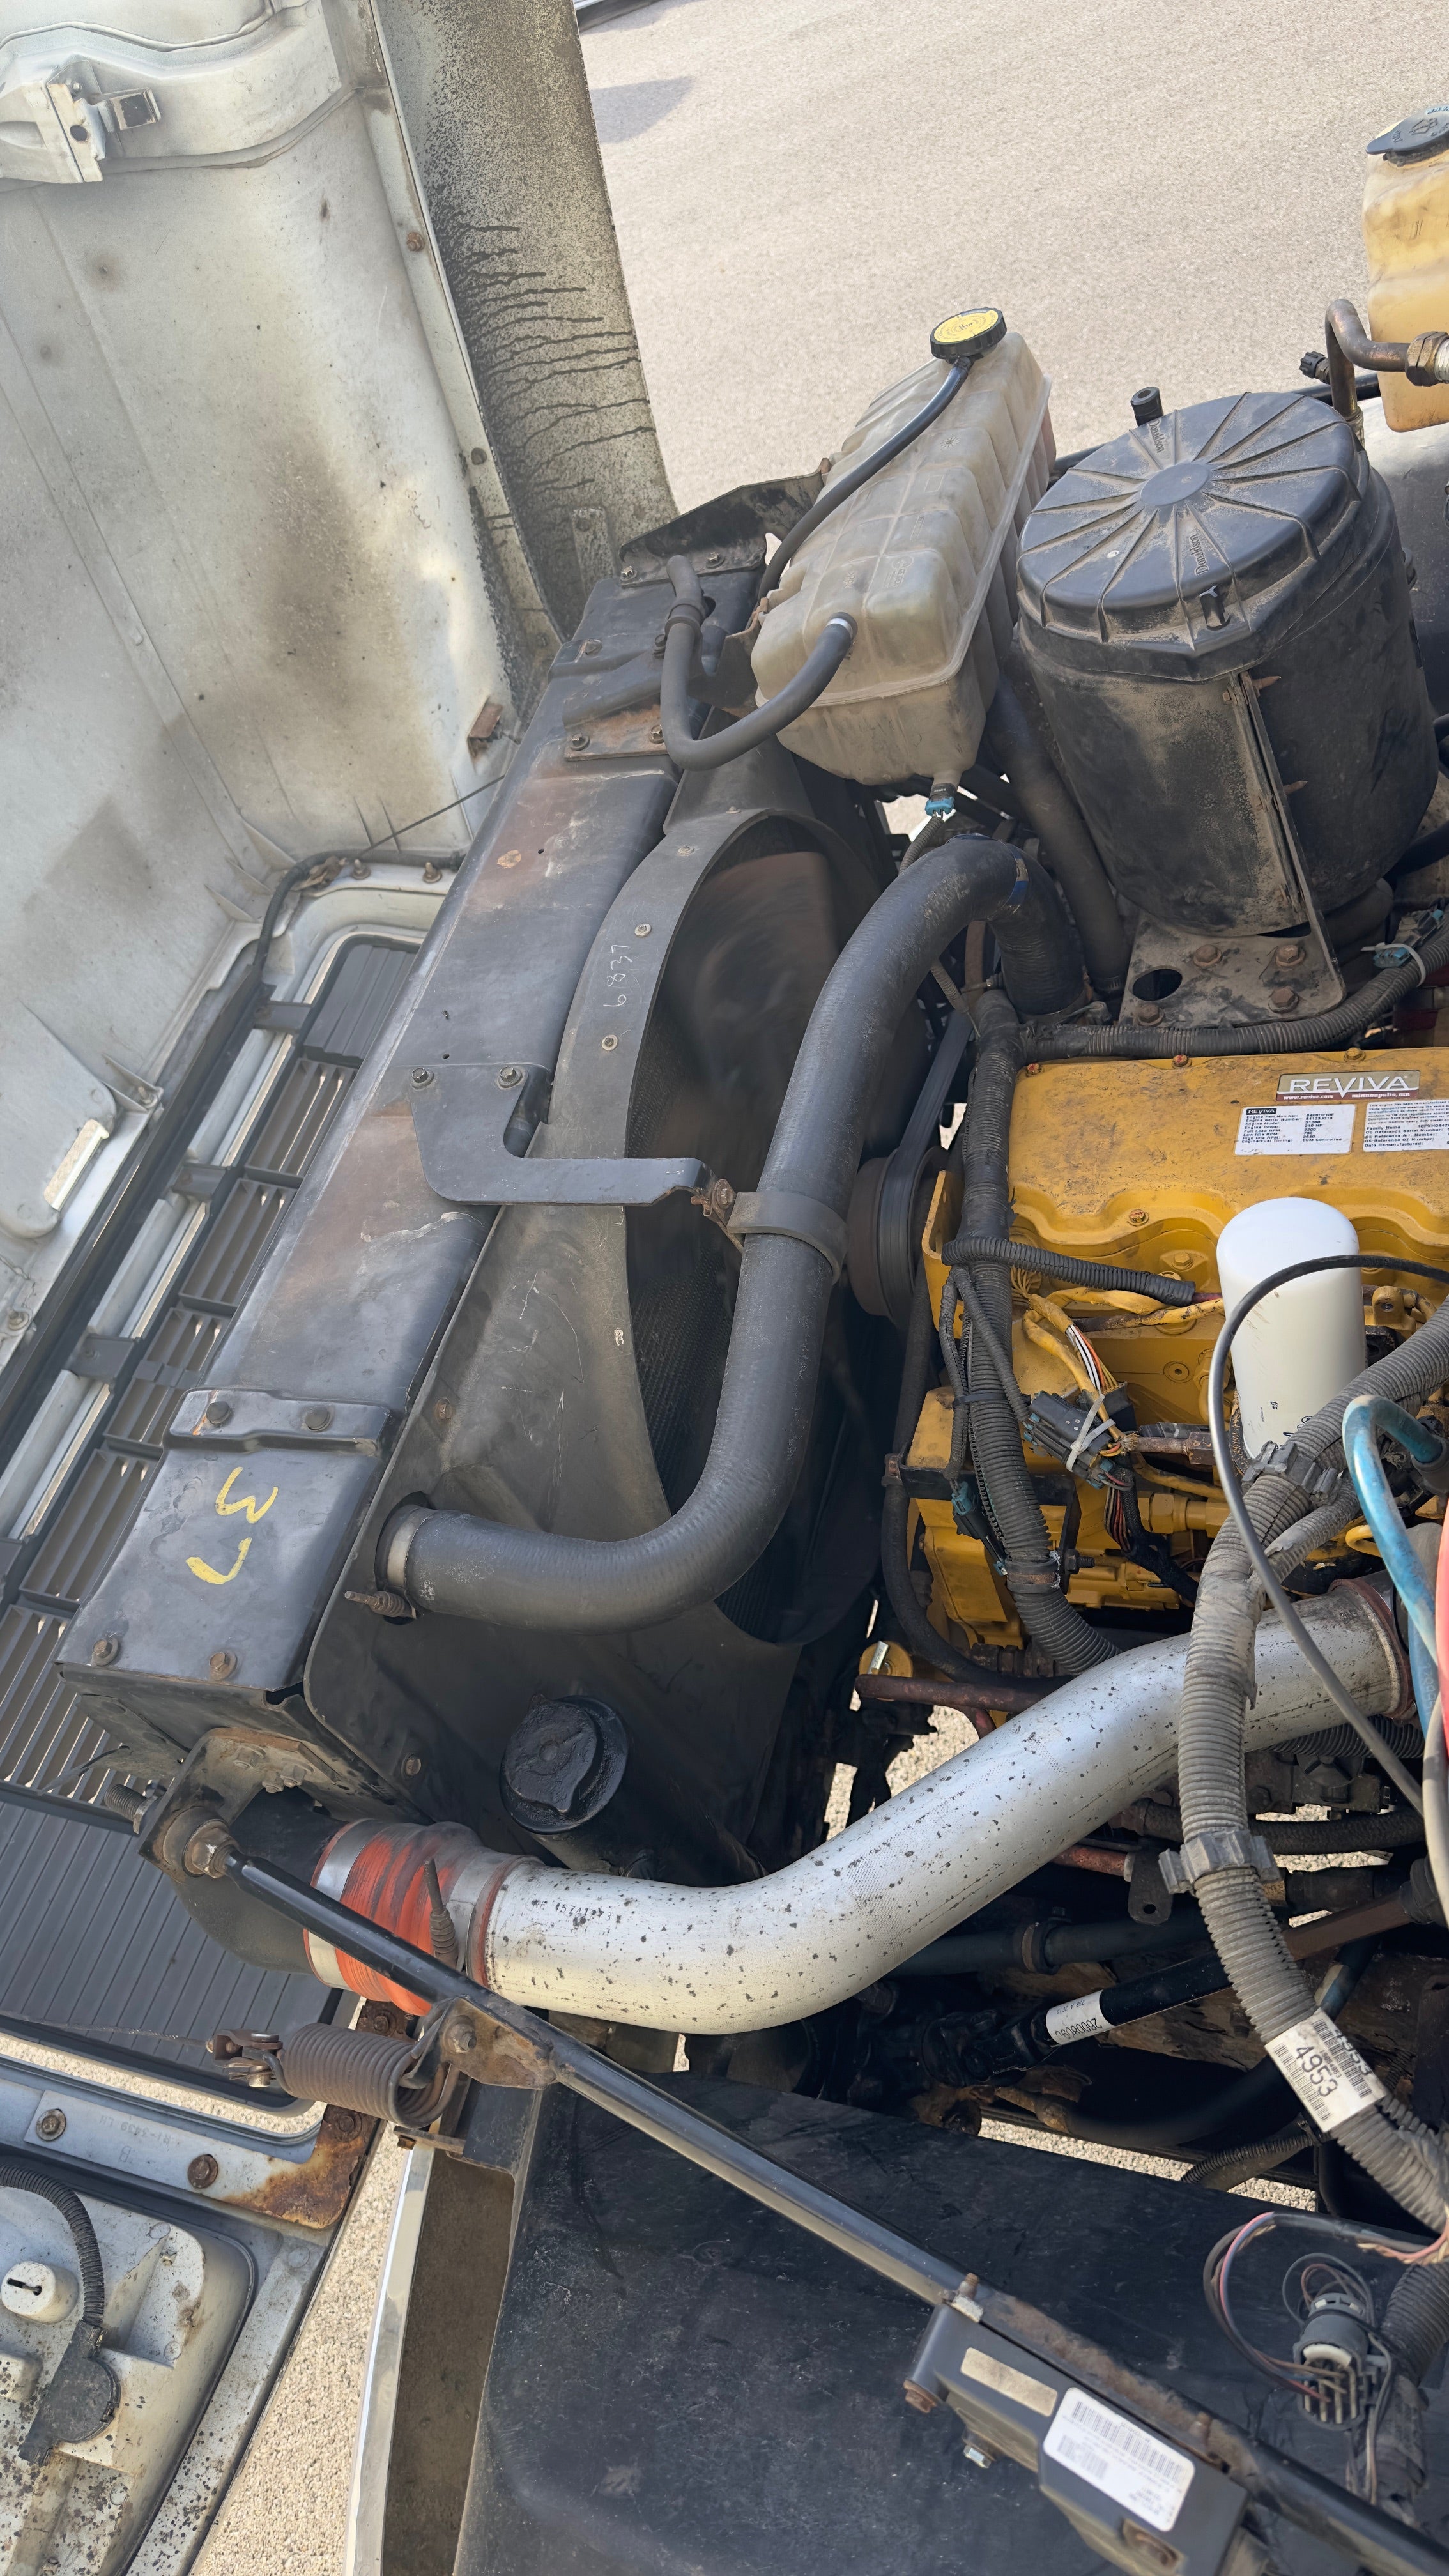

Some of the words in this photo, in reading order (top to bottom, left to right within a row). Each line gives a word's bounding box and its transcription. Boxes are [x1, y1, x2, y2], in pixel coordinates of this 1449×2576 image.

[1147, 420, 1165, 455] Donaldson
[1190, 534, 1210, 576] Donaldson
[602, 944, 632, 1007] 6837
[1289, 1077, 1409, 1098] REVIVA
[1295, 2044, 1338, 2097] 4953
